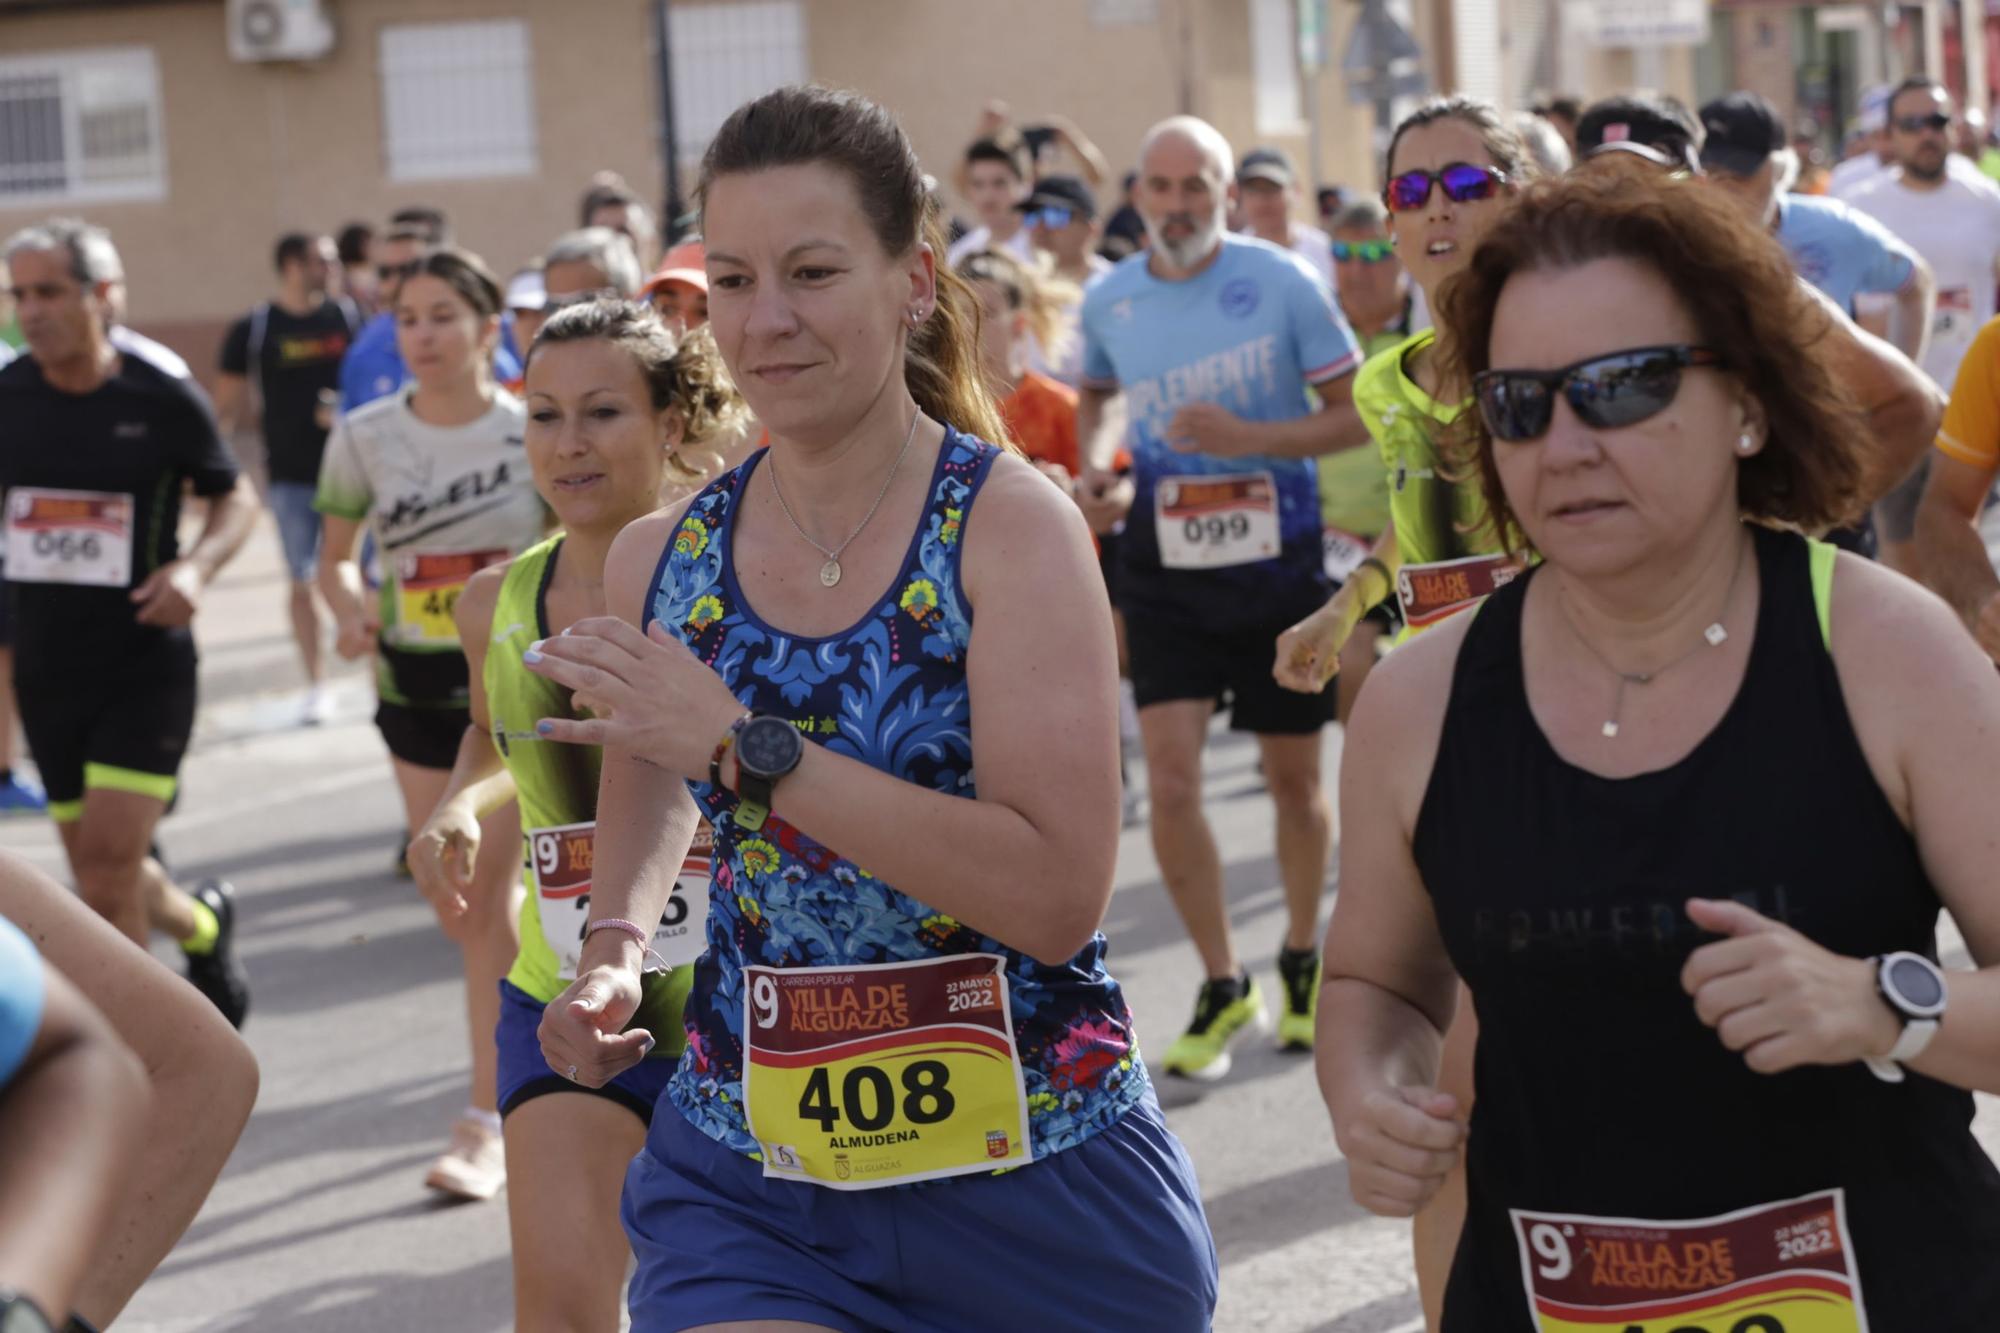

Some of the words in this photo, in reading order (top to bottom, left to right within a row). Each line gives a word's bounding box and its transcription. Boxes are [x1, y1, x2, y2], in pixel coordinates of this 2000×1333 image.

[1183, 512, 1250, 544] 099
[33, 532, 102, 561] 066
[815, 974, 856, 985] POPULAR
[946, 982, 958, 994] 22
[959, 978, 993, 991] MAYO
[784, 988, 860, 1013] VILLA
[867, 984, 908, 1010] DE
[948, 989, 995, 1013] 2022
[790, 1008, 910, 1032] ALGUAZAS
[798, 1059, 956, 1133] 408
[829, 1129, 920, 1149] ALMUDENA
[853, 1159, 902, 1174] ALGUAZAS
[1584, 1239, 1678, 1269] VILLA
[1683, 1238, 1734, 1269] DE
[1777, 1229, 1834, 1261] 2022
[1591, 1263, 1736, 1289] ALGUAZAS
